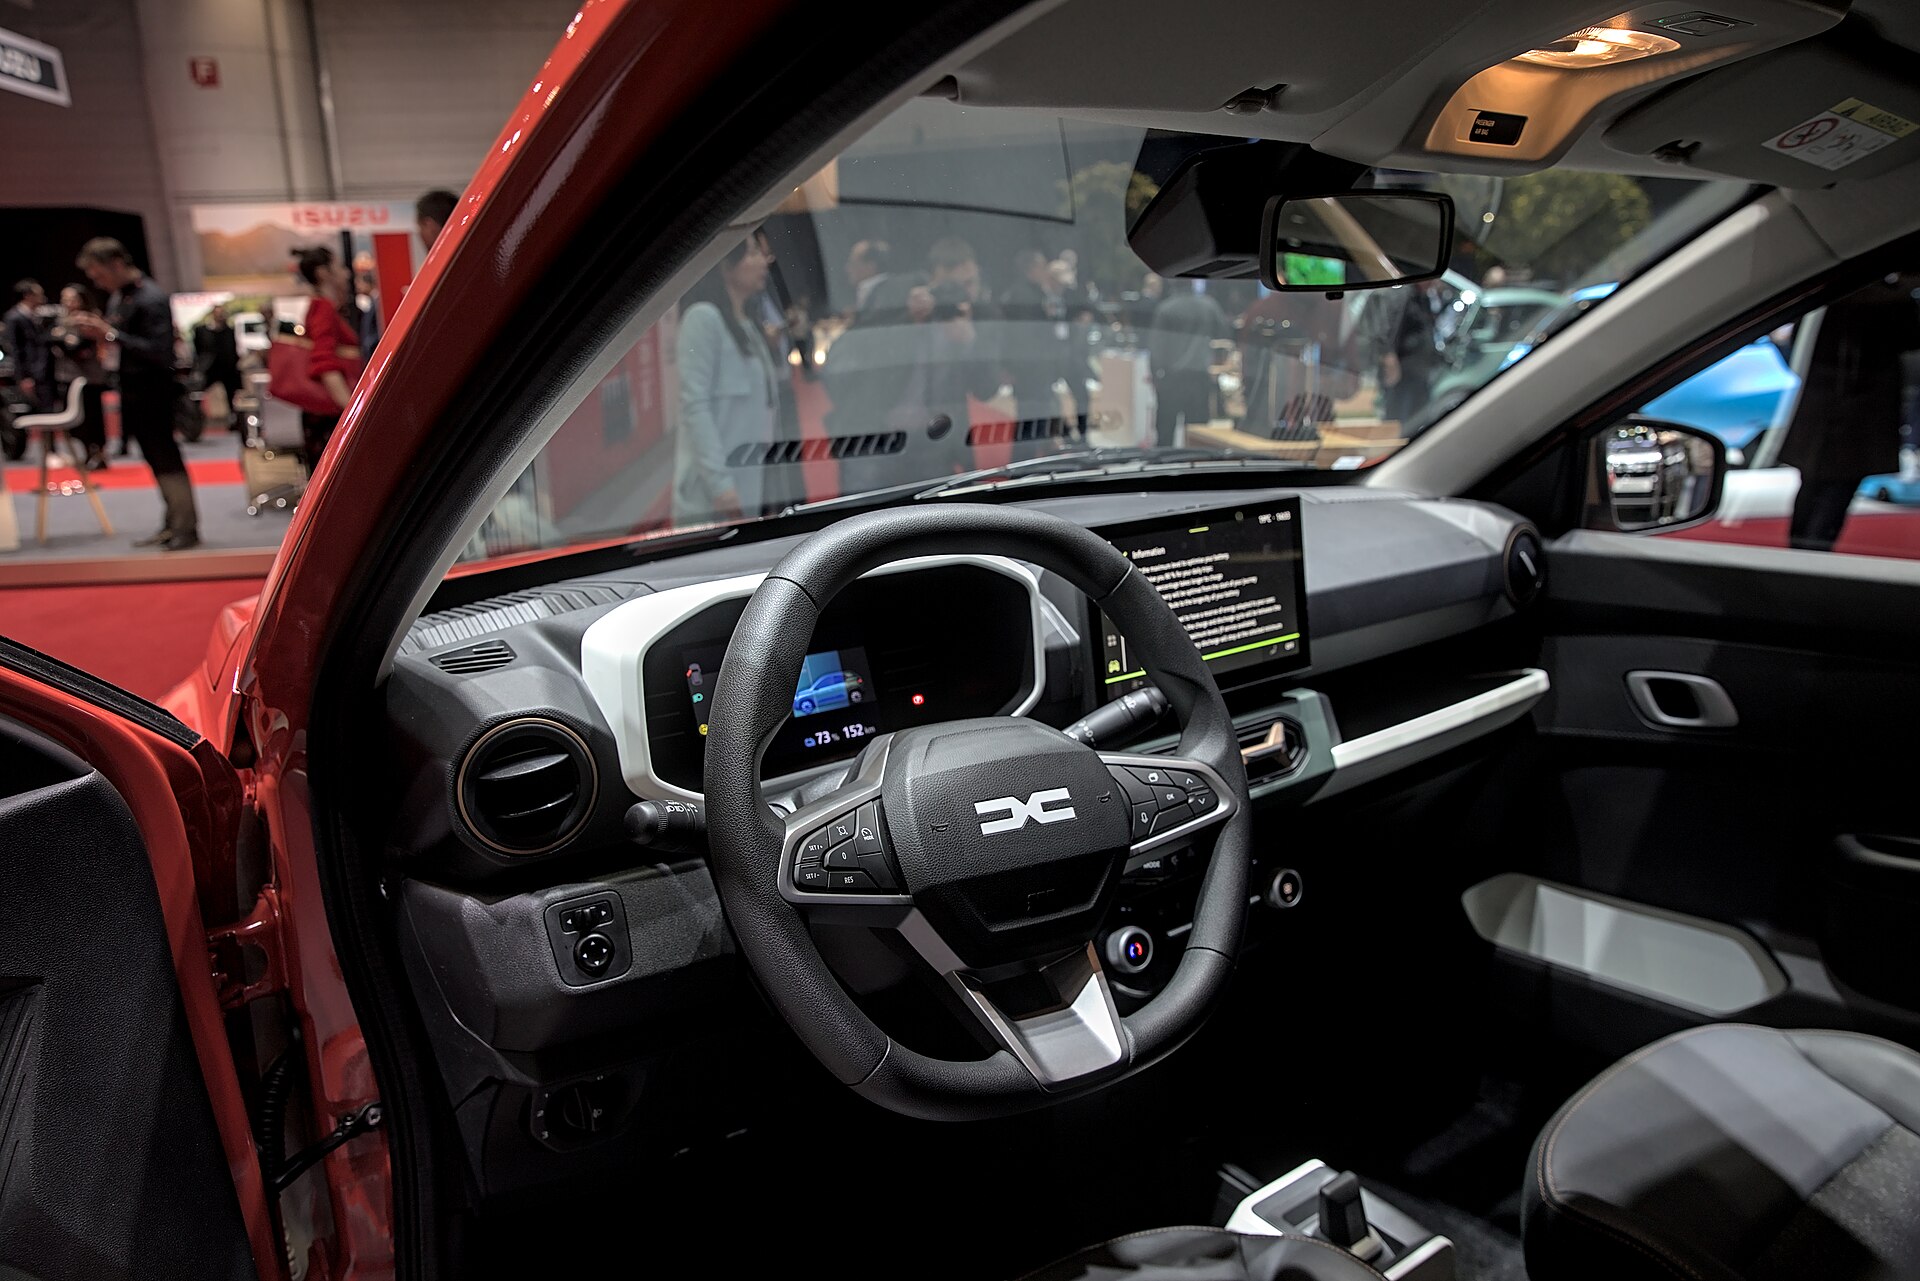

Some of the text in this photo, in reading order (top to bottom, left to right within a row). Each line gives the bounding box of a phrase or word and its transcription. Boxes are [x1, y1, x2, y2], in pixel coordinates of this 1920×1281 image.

[292, 204, 390, 228] ISUZU
[815, 730, 832, 745] 73
[842, 723, 865, 739] 152
[843, 875, 854, 884] RES
